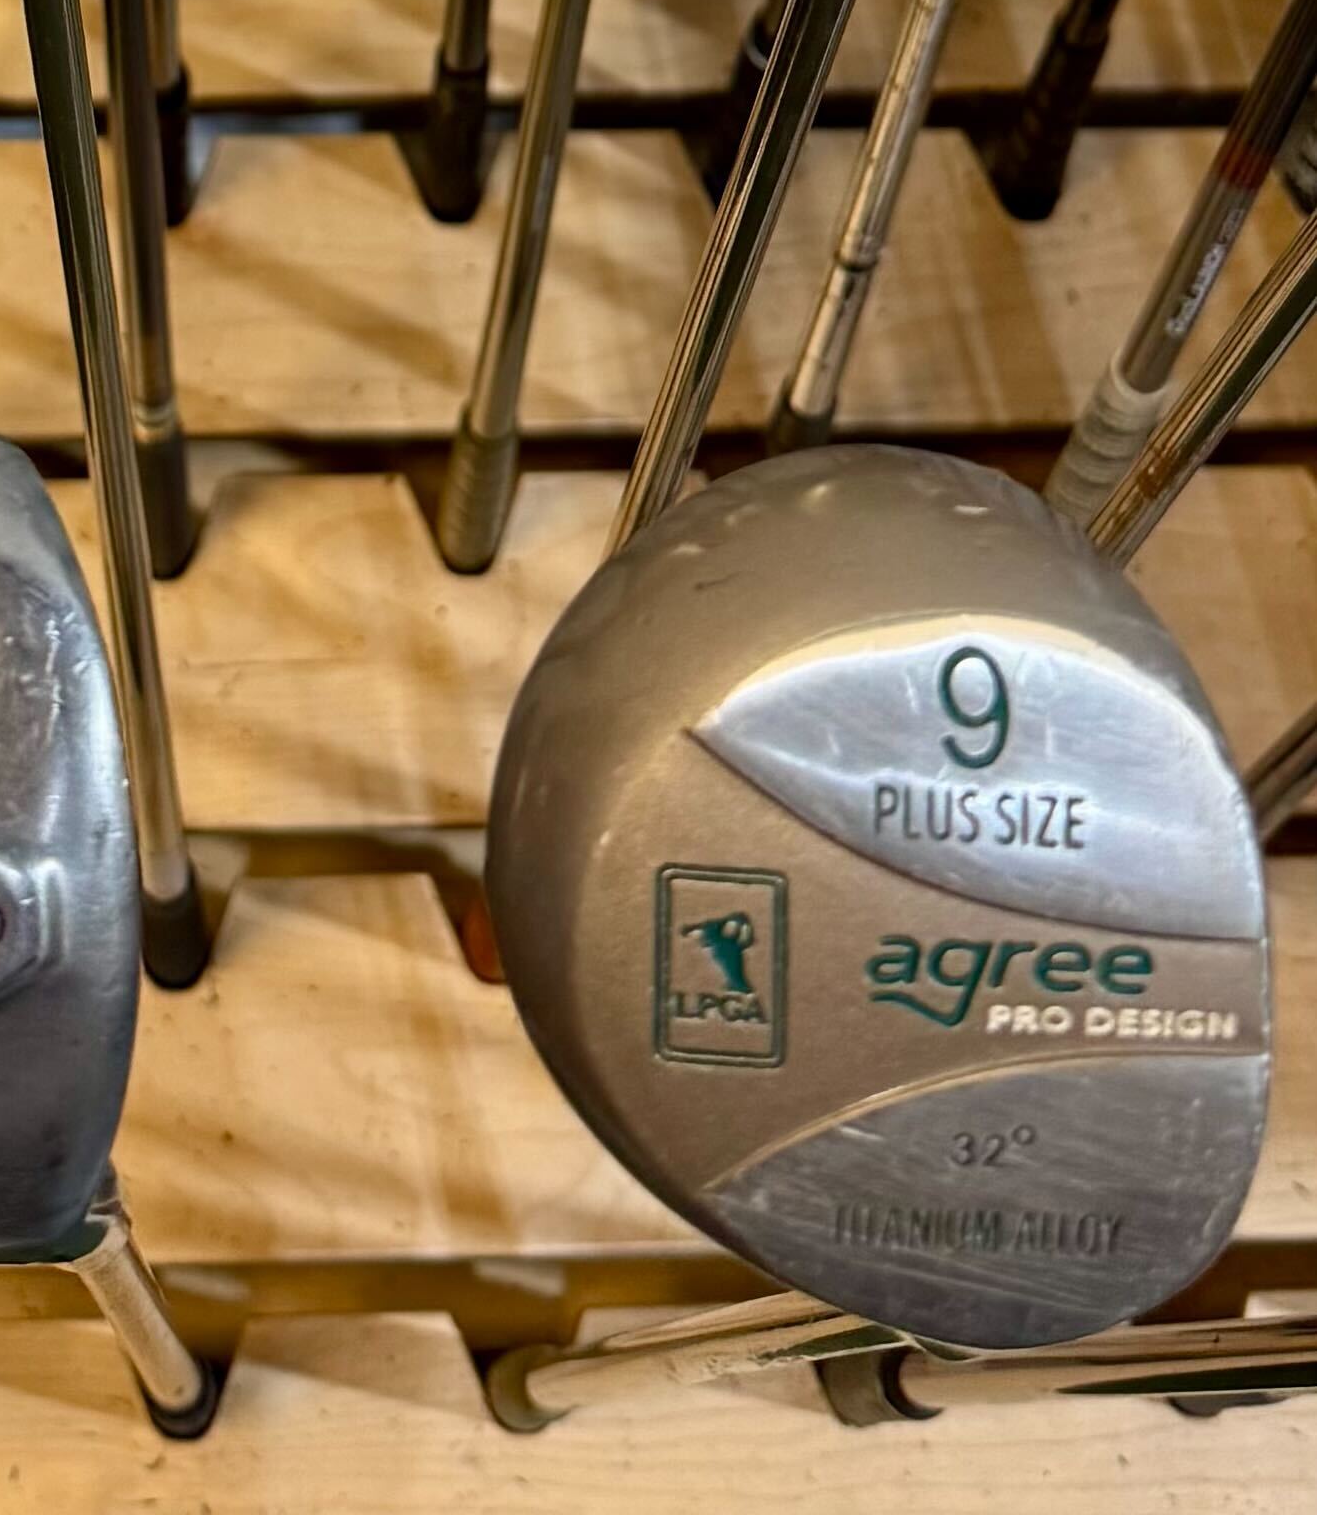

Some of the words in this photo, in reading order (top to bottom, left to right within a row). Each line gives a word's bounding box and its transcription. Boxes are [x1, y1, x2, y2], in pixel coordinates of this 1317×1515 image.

[938, 644, 1013, 770] 9
[873, 783, 980, 844] PLUS
[993, 794, 1085, 850] SIZE
[674, 991, 766, 1024] LPGA
[866, 932, 1153, 1027] agree
[985, 1005, 1069, 1036] PRO
[1085, 1005, 1238, 1041] DESIGN
[833, 1204, 1002, 1253] TITANIUM
[1012, 1210, 1123, 1255] ALLOY
